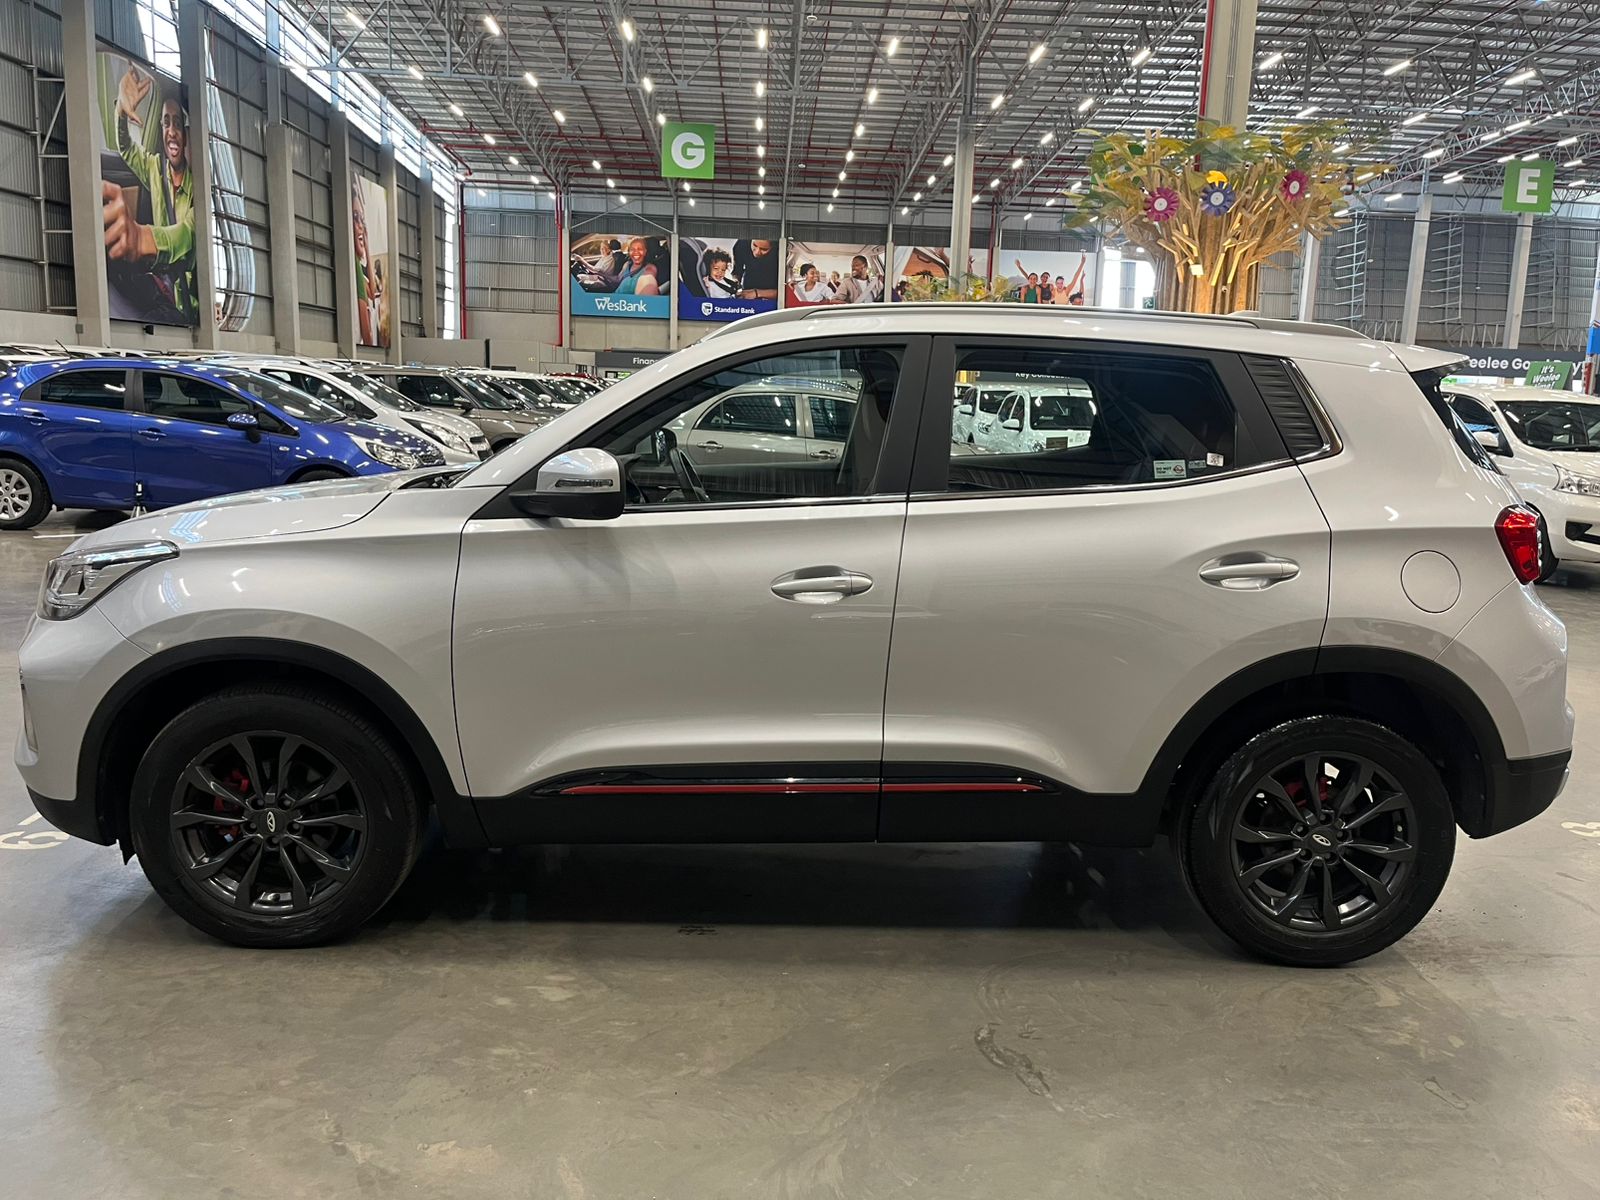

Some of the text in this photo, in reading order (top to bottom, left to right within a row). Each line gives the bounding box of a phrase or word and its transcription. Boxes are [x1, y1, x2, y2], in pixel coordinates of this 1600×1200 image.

[671, 131, 705, 170] G
[1516, 168, 1541, 204] E
[594, 297, 647, 312] WesBank
[714, 306, 740, 314] Standard
[632, 357, 659, 365] Finan
[1468, 356, 1509, 370] eelee
